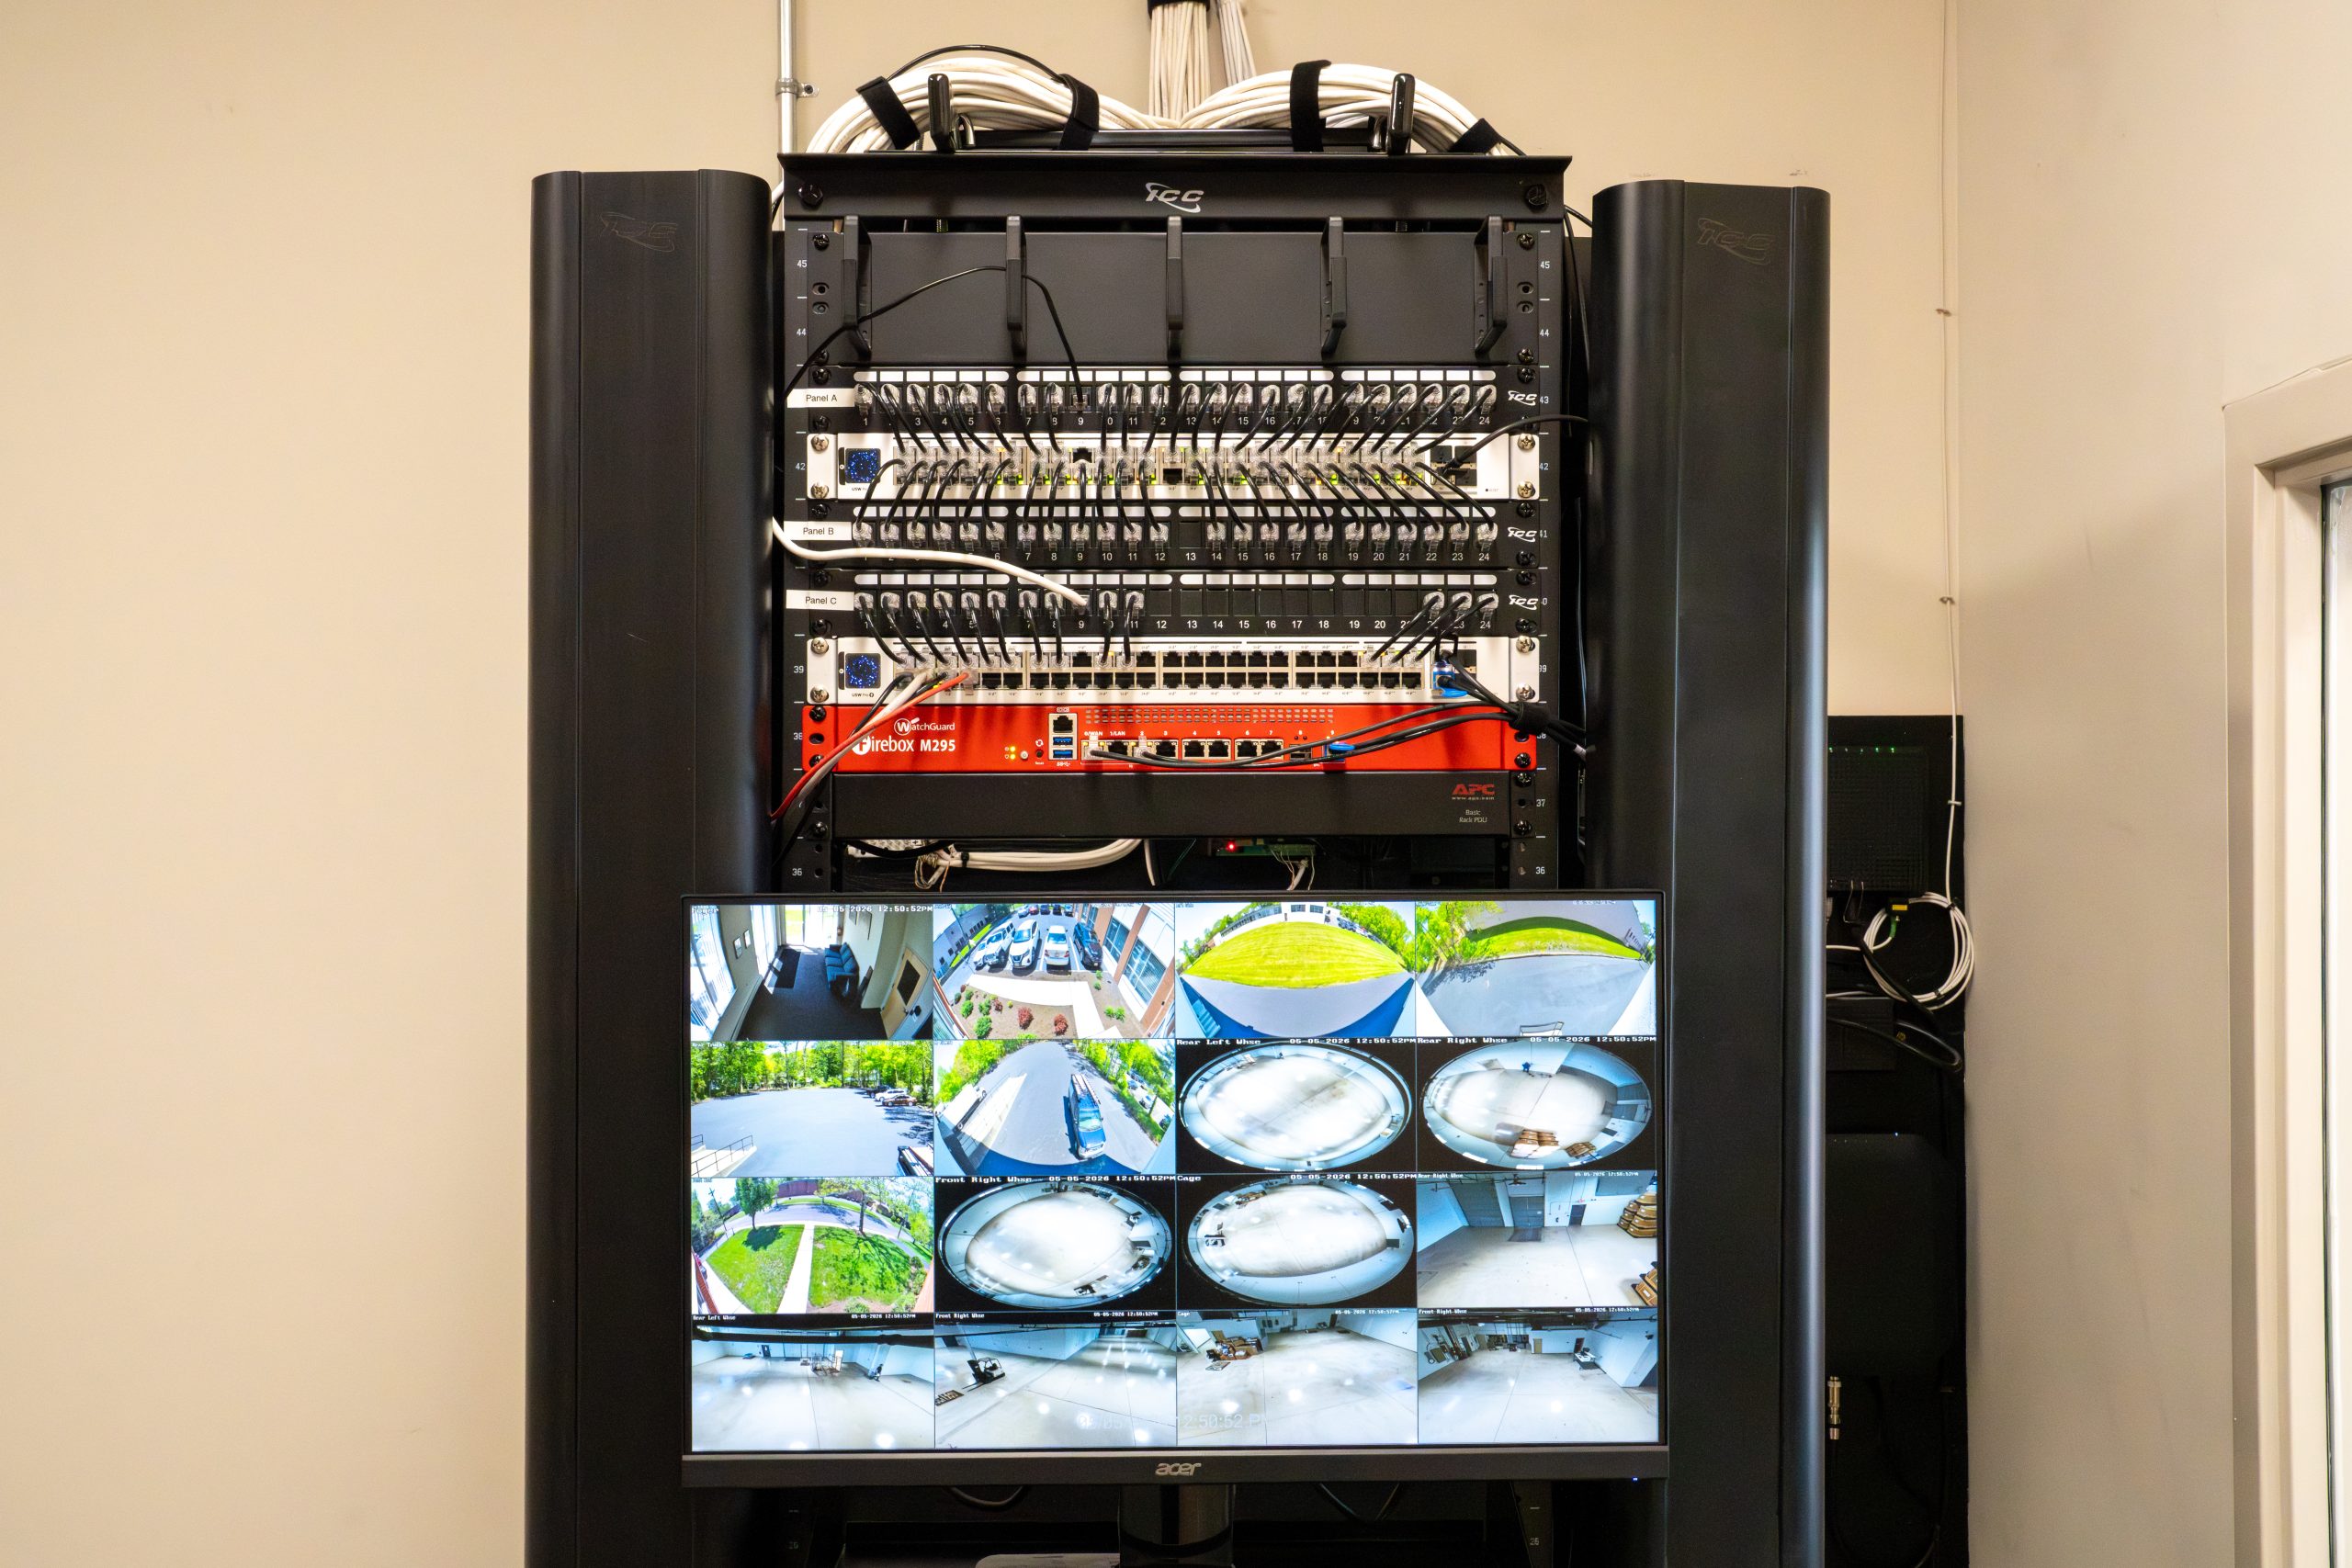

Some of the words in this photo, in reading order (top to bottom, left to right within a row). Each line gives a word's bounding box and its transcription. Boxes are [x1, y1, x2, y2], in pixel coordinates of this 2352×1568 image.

[797, 259, 808, 268] 45
[1540, 260, 1550, 269] 45
[796, 328, 807, 336] 44
[1540, 328, 1550, 337] 44
[805, 393, 829, 402] Panel
[831, 393, 838, 402] A
[1539, 395, 1549, 404] 43
[864, 417, 868, 426] 1
[915, 417, 921, 426] 3
[941, 417, 948, 426] 4
[968, 417, 975, 426] 5
[1025, 417, 1031, 426] 7
[1078, 417, 1084, 426] 9
[1128, 417, 1137, 426] 11
[1185, 417, 1196, 426] 13
[1238, 417, 1250, 426] 15
[1264, 417, 1275, 426] 16
[1479, 417, 1490, 426] 24
[795, 462, 806, 470] 42
[1539, 462, 1549, 470] 42
[802, 526, 825, 536] Panel
[827, 526, 834, 536] B
[994, 553, 1001, 561] 6
[1025, 553, 1031, 561] 7
[1051, 553, 1057, 561] 8
[1077, 553, 1083, 561] 9
[1102, 553, 1113, 561] 10
[1128, 553, 1137, 561] 11
[1155, 553, 1166, 561] 12
[1185, 553, 1196, 561] 13
[1211, 553, 1222, 561] 14
[1238, 553, 1249, 561] 15
[1264, 553, 1275, 561] 16
[1290, 553, 1301, 561] 17
[1317, 553, 1329, 561] 18
[1348, 553, 1359, 561] 19
[1373, 553, 1385, 561] 20
[1398, 553, 1409, 561] 21
[1426, 553, 1437, 561] 22
[1452, 553, 1464, 561] 23
[1478, 553, 1490, 561] 24
[805, 596, 827, 605] Panel
[829, 596, 837, 605] C
[942, 621, 948, 629] 4
[1078, 621, 1084, 629] 9
[1130, 621, 1139, 629] 11
[1156, 621, 1167, 629] 12
[1186, 621, 1198, 629] 13
[1213, 621, 1224, 629] 14
[1238, 621, 1250, 629] 15
[1265, 621, 1277, 629] 16
[1292, 621, 1303, 629] 17
[1317, 621, 1330, 629] 18
[1349, 621, 1360, 629] 19
[1374, 621, 1386, 629] 20
[1479, 621, 1491, 629] 24
[793, 665, 804, 673] 39
[893, 718, 956, 735] WatchGuard
[851, 736, 914, 754] Firebox
[920, 739, 956, 752] M295
[1451, 783, 1496, 795] APC
[1535, 798, 1546, 807] 37
[792, 868, 803, 876] 36
[1535, 866, 1545, 874] 36
[1447, 1036, 1477, 1044] Right
[1154, 1462, 1202, 1476] acer
